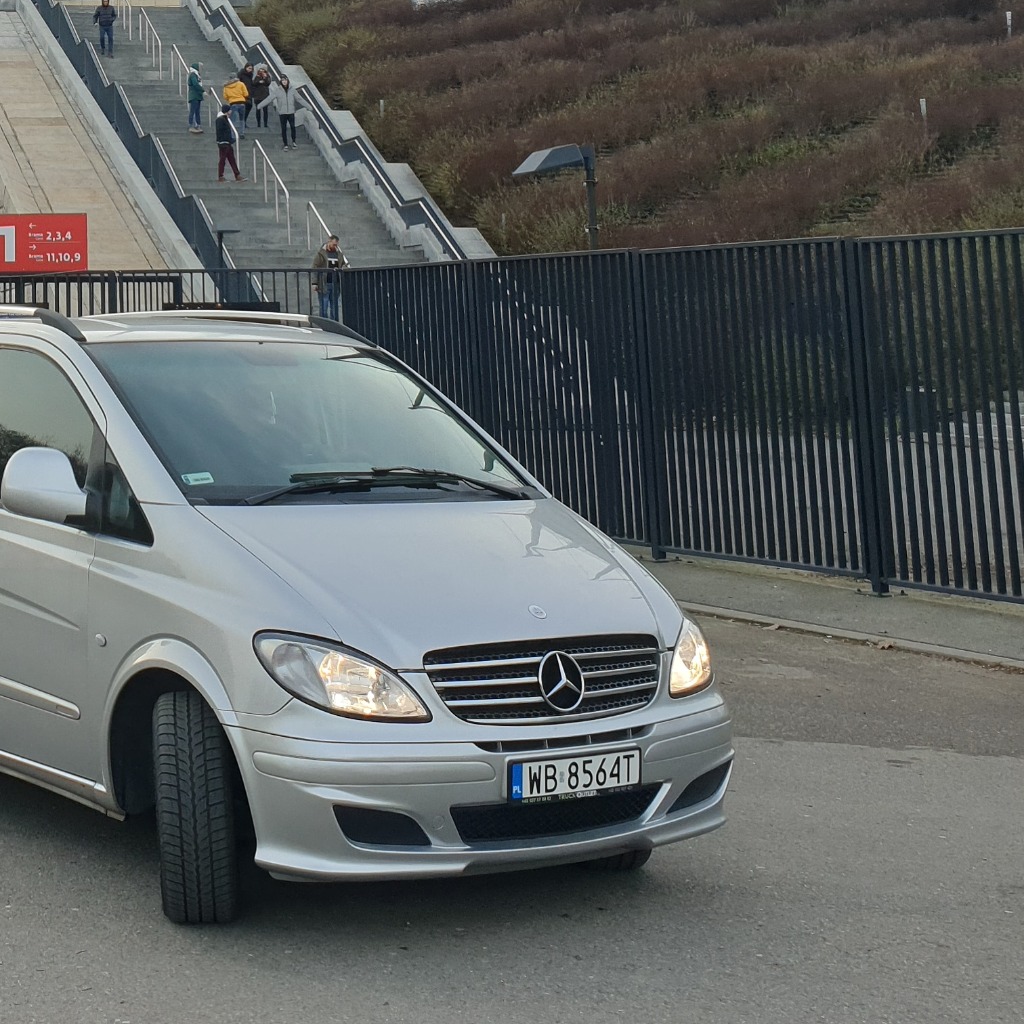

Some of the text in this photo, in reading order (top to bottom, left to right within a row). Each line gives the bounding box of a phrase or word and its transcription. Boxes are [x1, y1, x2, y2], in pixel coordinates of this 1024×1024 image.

[46, 231, 72, 242] 2,3,4
[46, 252, 81, 263] 11,10,9
[528, 754, 635, 795] WB 8564T
[512, 786, 522, 794] PL
